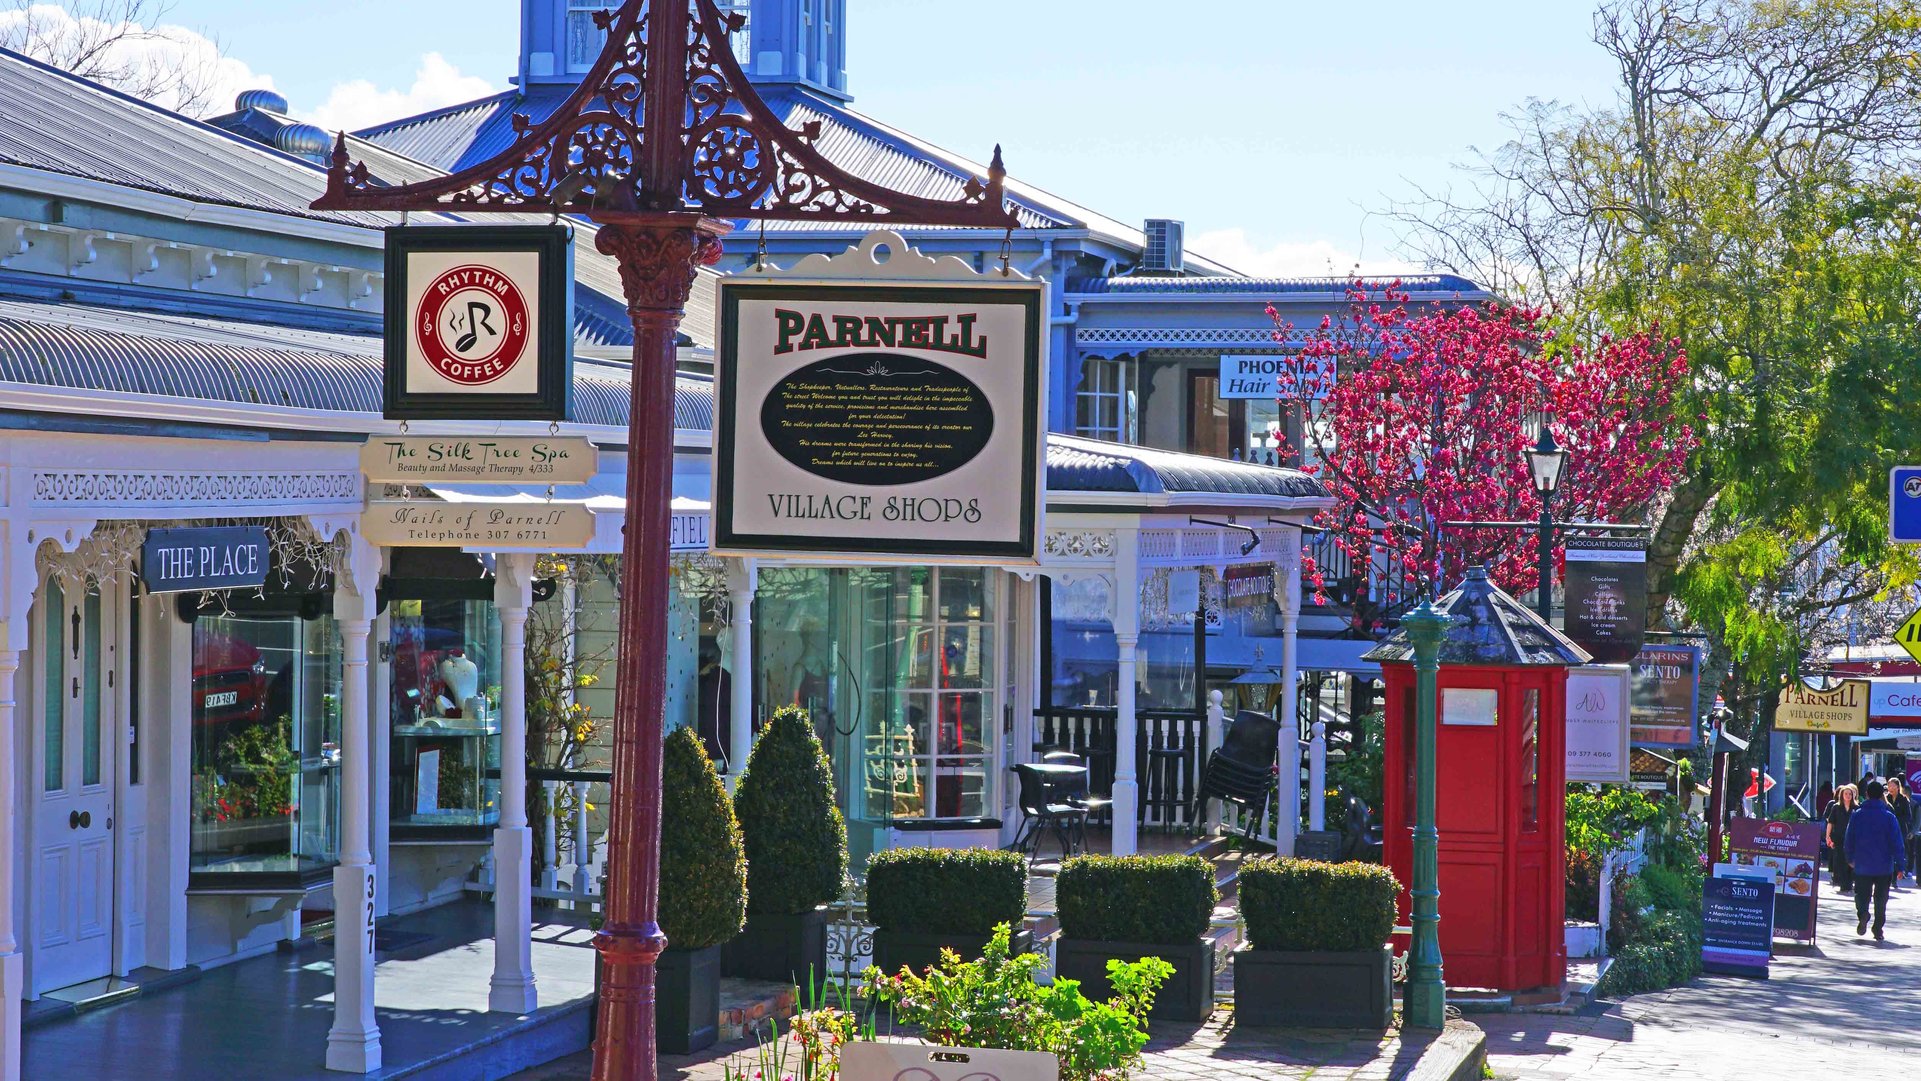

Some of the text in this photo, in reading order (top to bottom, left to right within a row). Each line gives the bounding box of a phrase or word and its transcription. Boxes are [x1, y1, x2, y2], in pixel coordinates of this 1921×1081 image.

[437, 272, 509, 296] RHYTHM
[774, 308, 988, 360] PARNELL
[440, 358, 504, 378] COFFEE
[1238, 360, 1318, 374] PHOENI
[1228, 378, 1270, 393] Hair
[384, 442, 570, 465] The Silk Tree Spa
[397, 463, 554, 475] Beauty and Massage Therapy 4/333
[768, 494, 982, 523] VILLAGE SHOPS
[390, 508, 566, 530] Nails of Parnell
[408, 530, 547, 542] Telephone 307 6771
[672, 516, 710, 544] FIEL
[158, 544, 258, 580] THE PLACE
[1640, 664, 1680, 679] SENTO
[1785, 682, 1857, 707] PARNELL
[1790, 710, 1825, 719] VILLAGE
[1732, 887, 1759, 897] SENTO
[1708, 917, 1737, 926] Anti-aging
